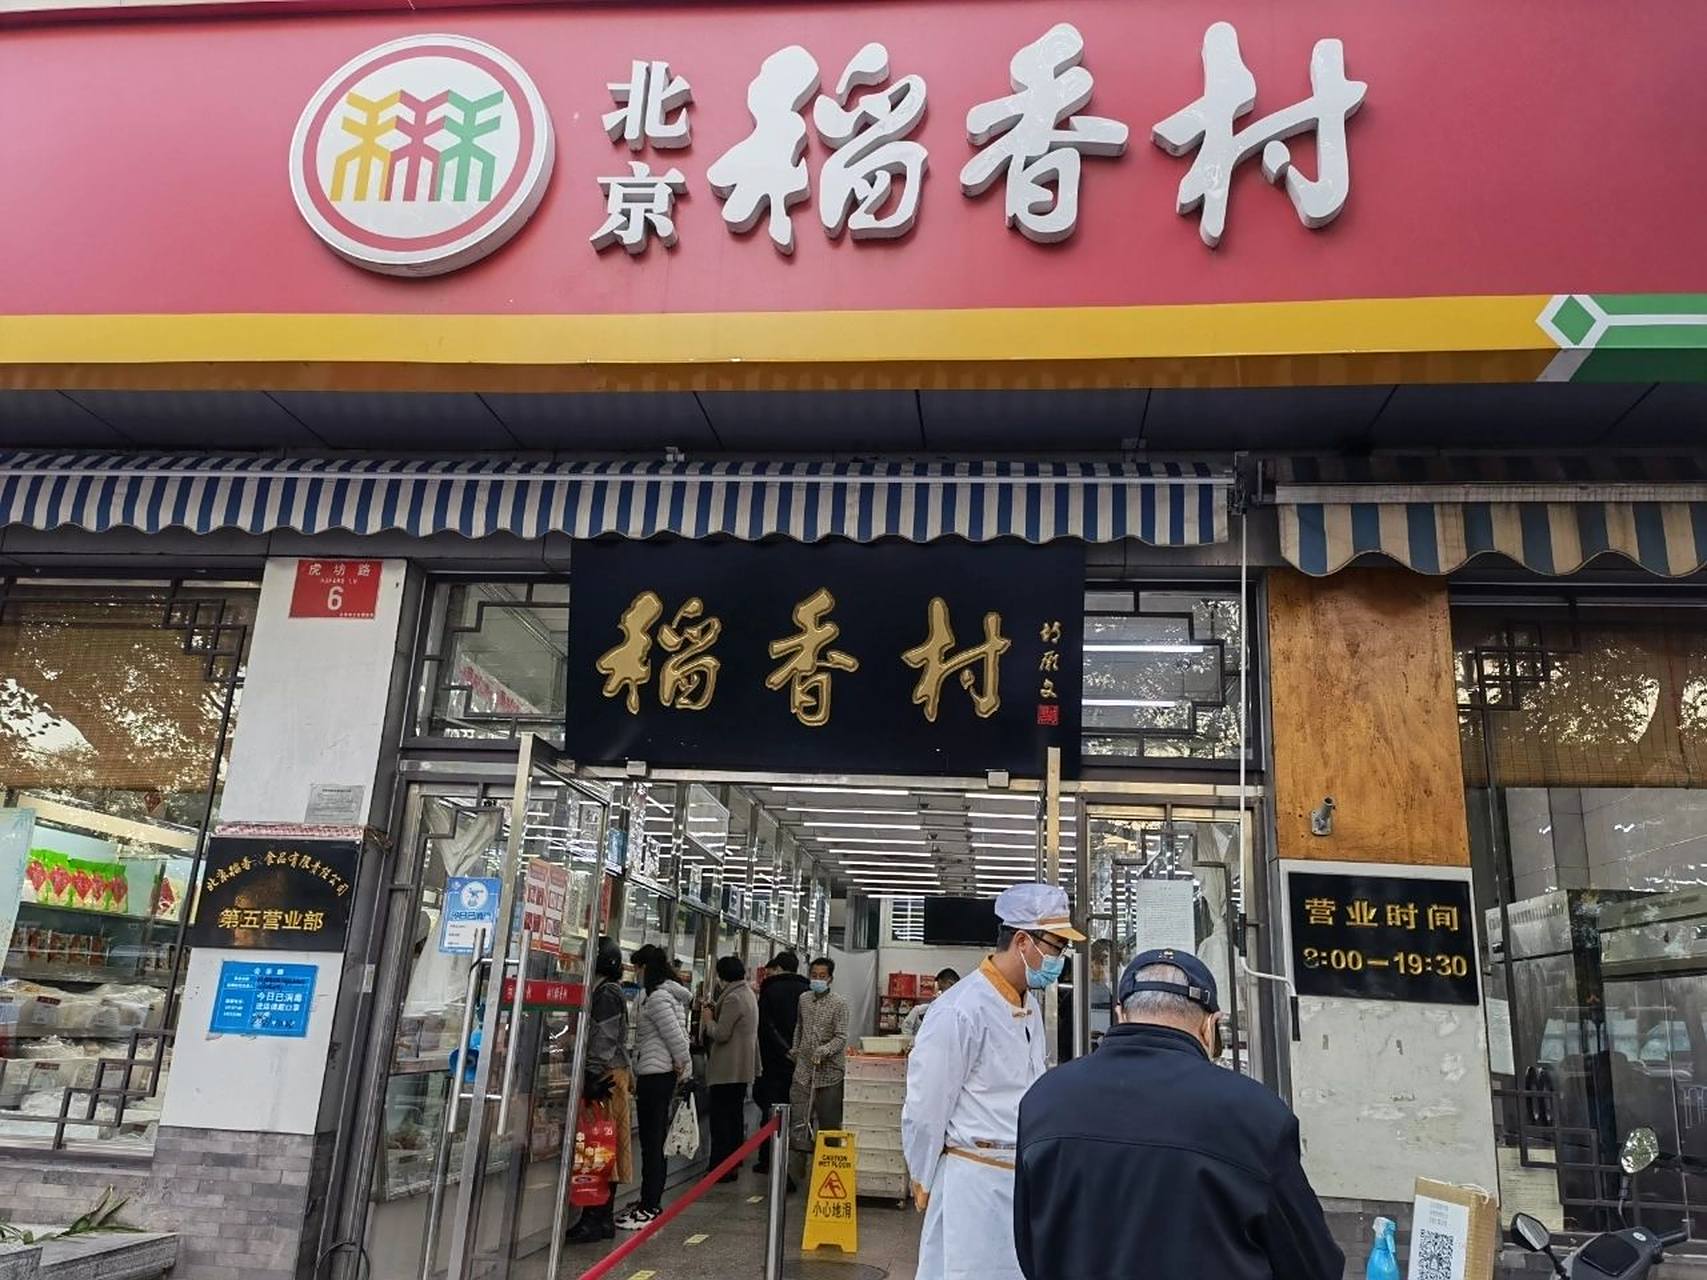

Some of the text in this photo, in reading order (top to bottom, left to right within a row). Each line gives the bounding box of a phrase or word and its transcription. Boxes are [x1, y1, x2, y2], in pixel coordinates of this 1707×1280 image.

[707, 22, 1369, 255] 稻香村
[590, 60, 693, 255] 北京
[308, 562, 371, 577] 虎坊路
[327, 585, 344, 611] 6
[596, 586, 1012, 727] 稻香村
[206, 850, 350, 897] 北京稻香食品有限责任公司
[218, 908, 325, 932] 第五营业部
[1304, 898, 1459, 932] 营业时间
[812, 1201, 852, 1219] 小心地滑
